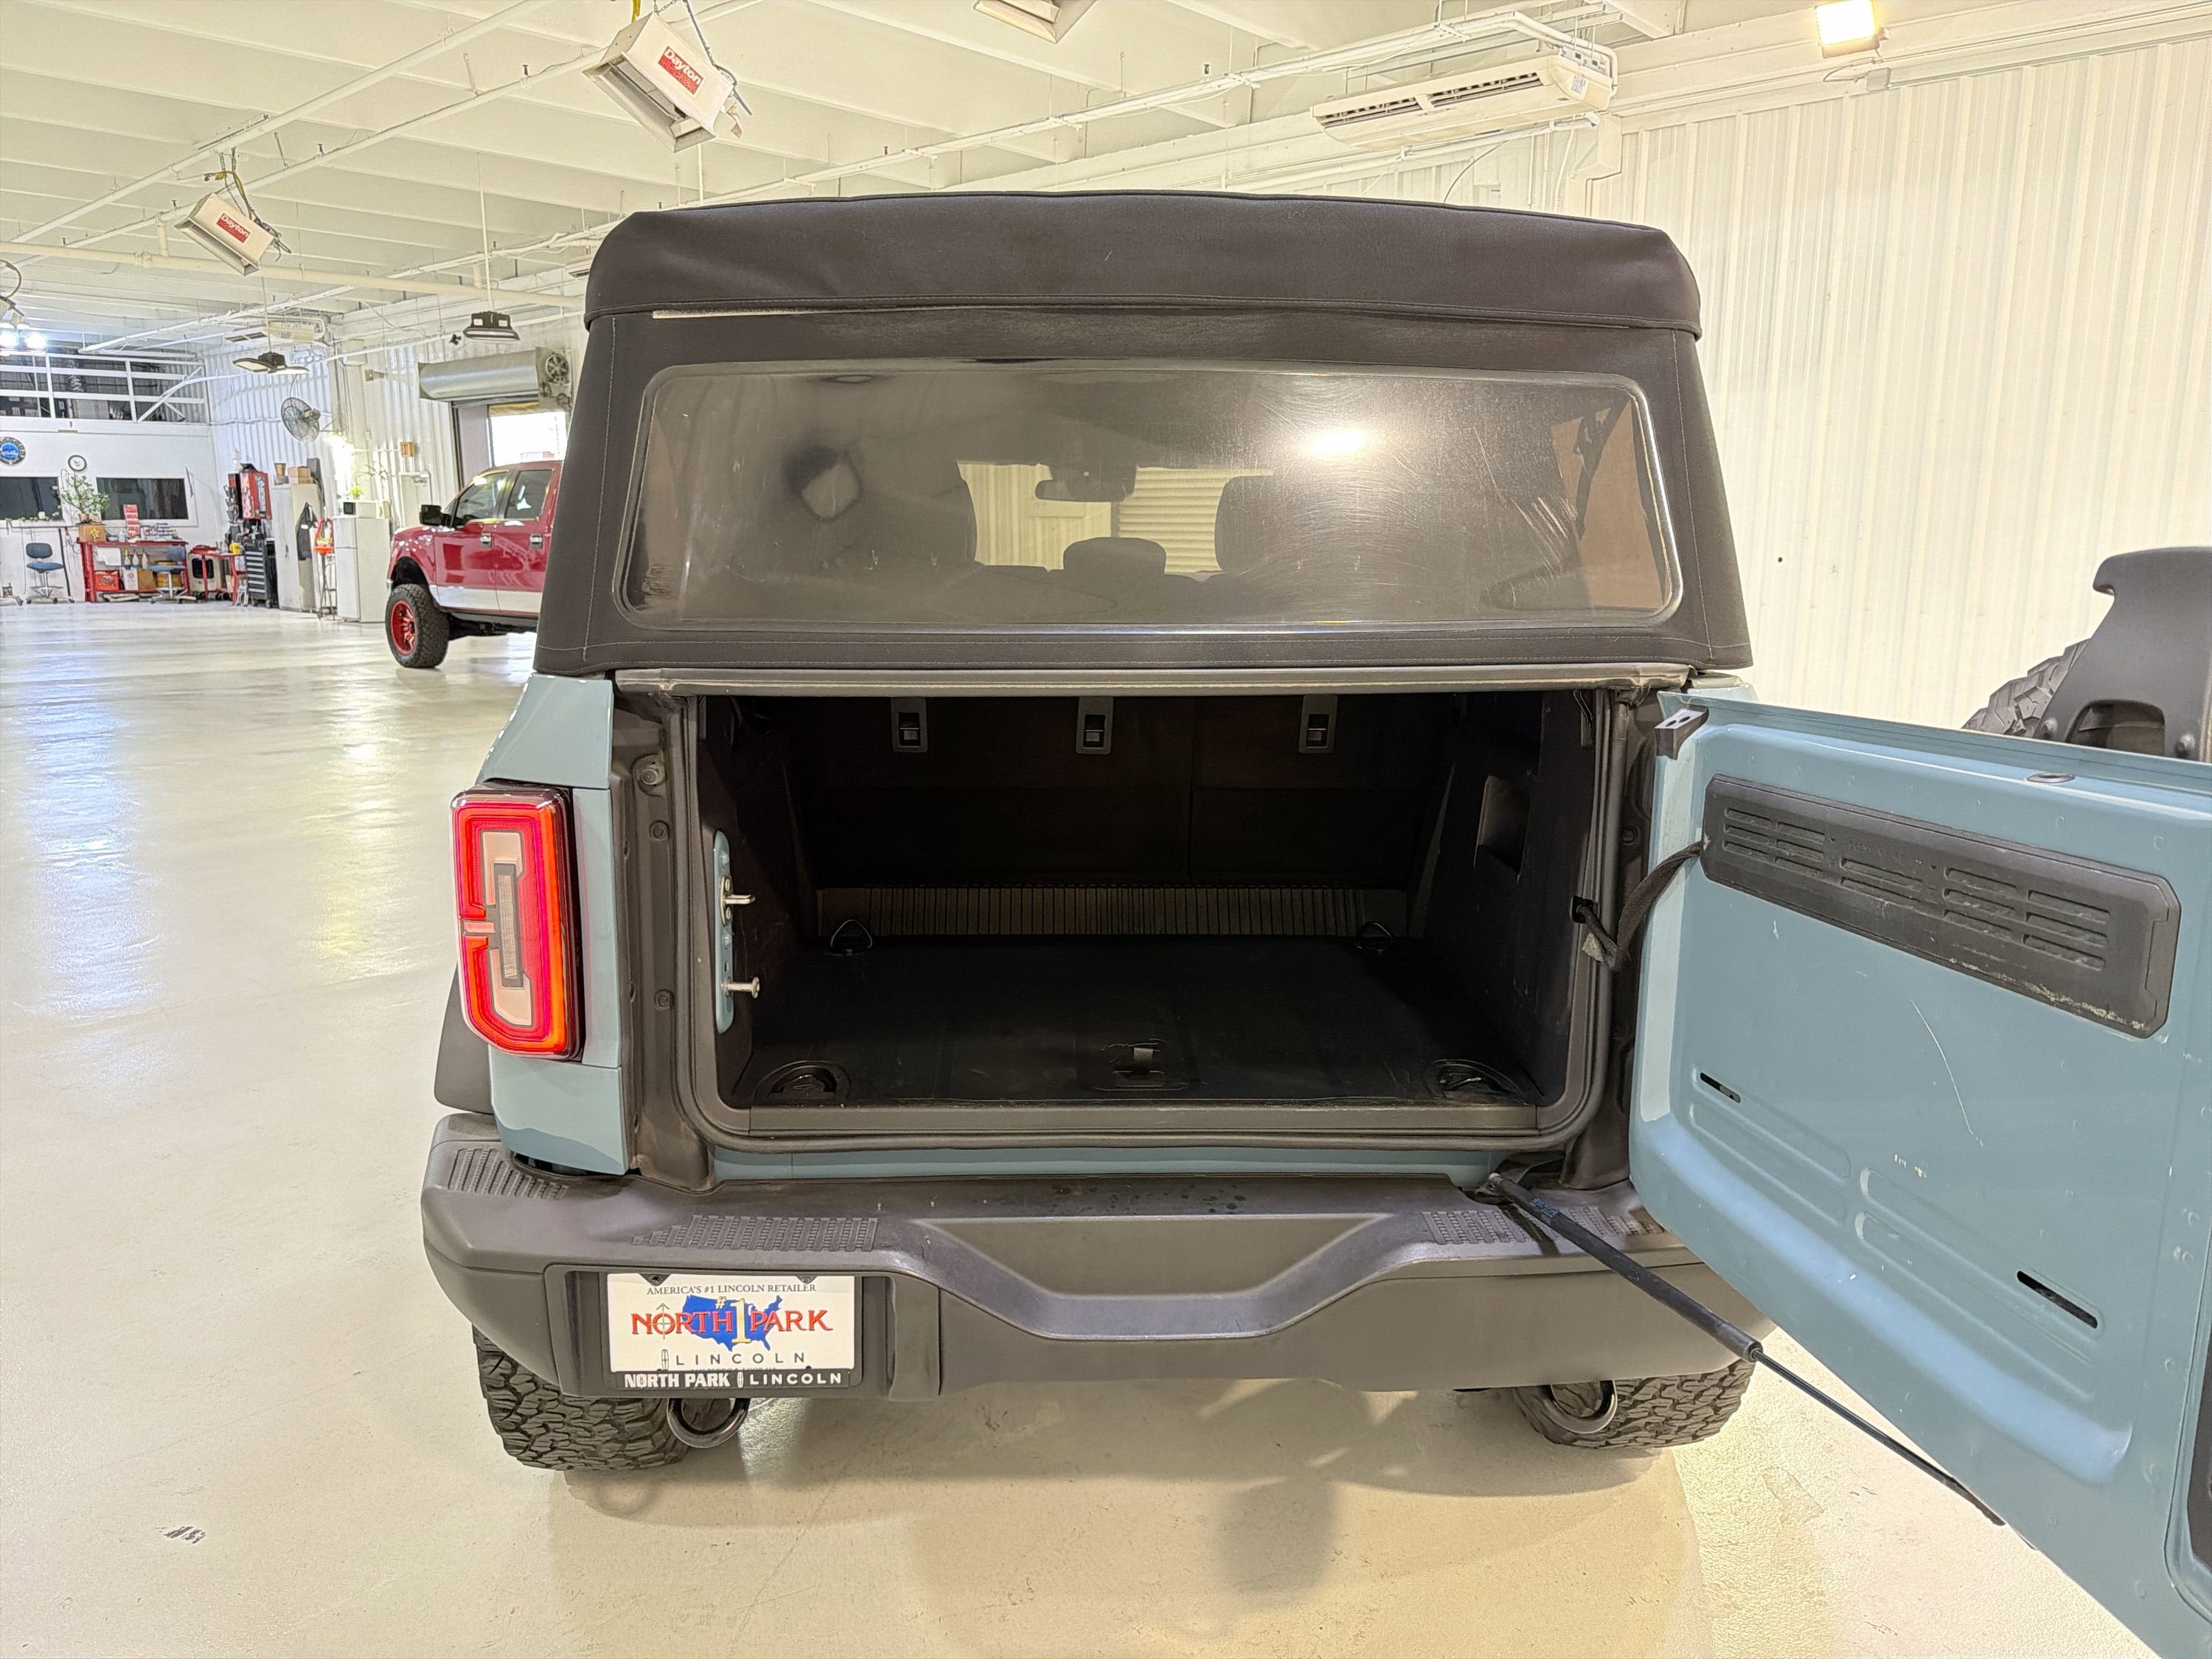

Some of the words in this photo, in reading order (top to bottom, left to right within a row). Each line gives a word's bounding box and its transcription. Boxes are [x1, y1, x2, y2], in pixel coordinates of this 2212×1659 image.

[664, 48, 701, 85] Dayton
[221, 215, 248, 237] Dayton
[647, 1284, 702, 1295] AMERICA'S
[704, 1284, 714, 1293] #1
[717, 1284, 765, 1293] LINCOLN
[768, 1283, 817, 1292] RETAILER
[631, 1310, 733, 1335] NORTH
[750, 1310, 834, 1332] PARK
[675, 1352, 805, 1366] LINCOLN
[624, 1373, 680, 1388] NORTH
[684, 1372, 731, 1388] PARK
[749, 1372, 842, 1385] LINCOLN
